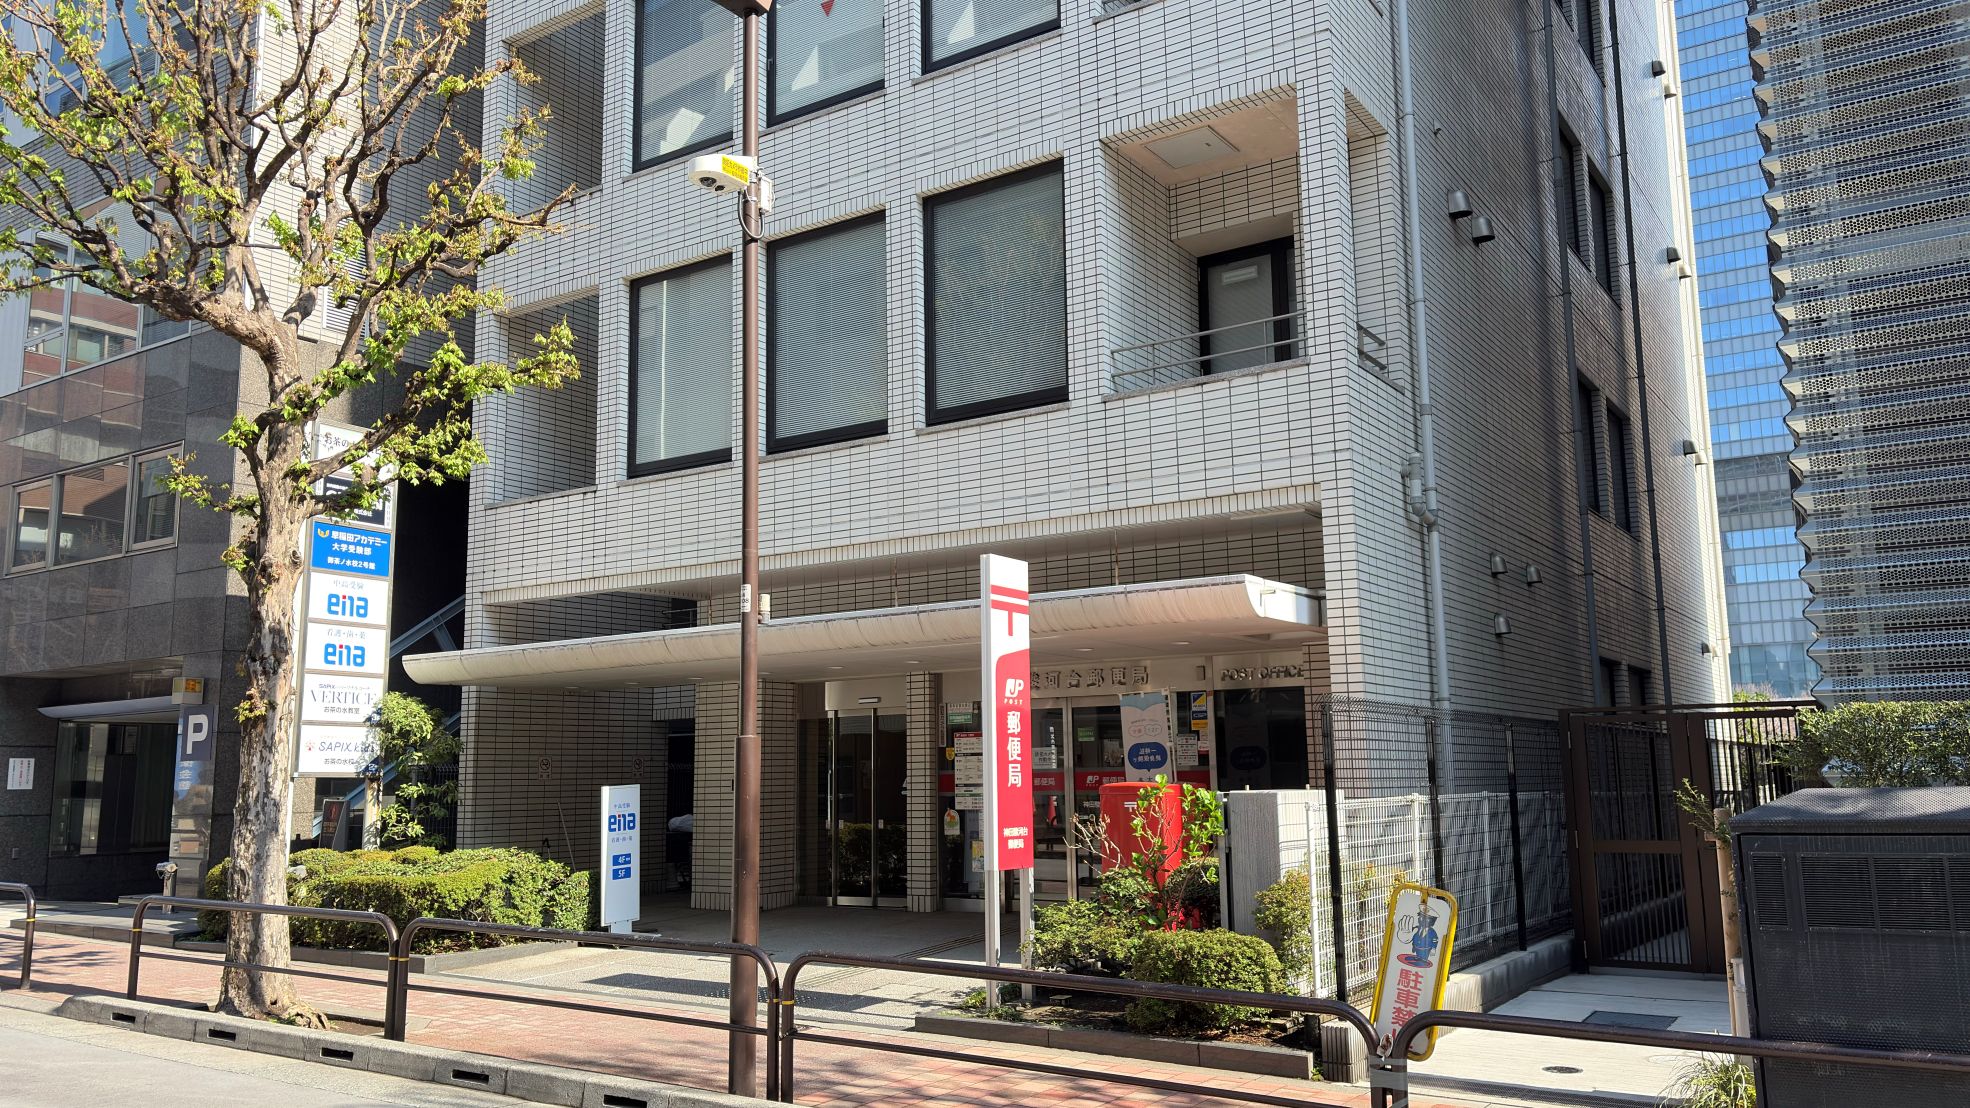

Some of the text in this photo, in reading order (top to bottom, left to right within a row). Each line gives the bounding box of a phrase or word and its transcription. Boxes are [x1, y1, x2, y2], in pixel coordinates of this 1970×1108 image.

[331, 530, 388, 547] 早稲田アカデミー
[327, 593, 368, 618] ena
[323, 643, 366, 667] ena
[1220, 667, 1256, 681] POST
[187, 714, 208, 754] P
[318, 741, 352, 753] SAPIX
[1007, 710, 1022, 788] 郵便局
[608, 812, 636, 833] ena
[618, 869, 626, 878] 5F
[1391, 968, 1424, 1039] 駐車禁
